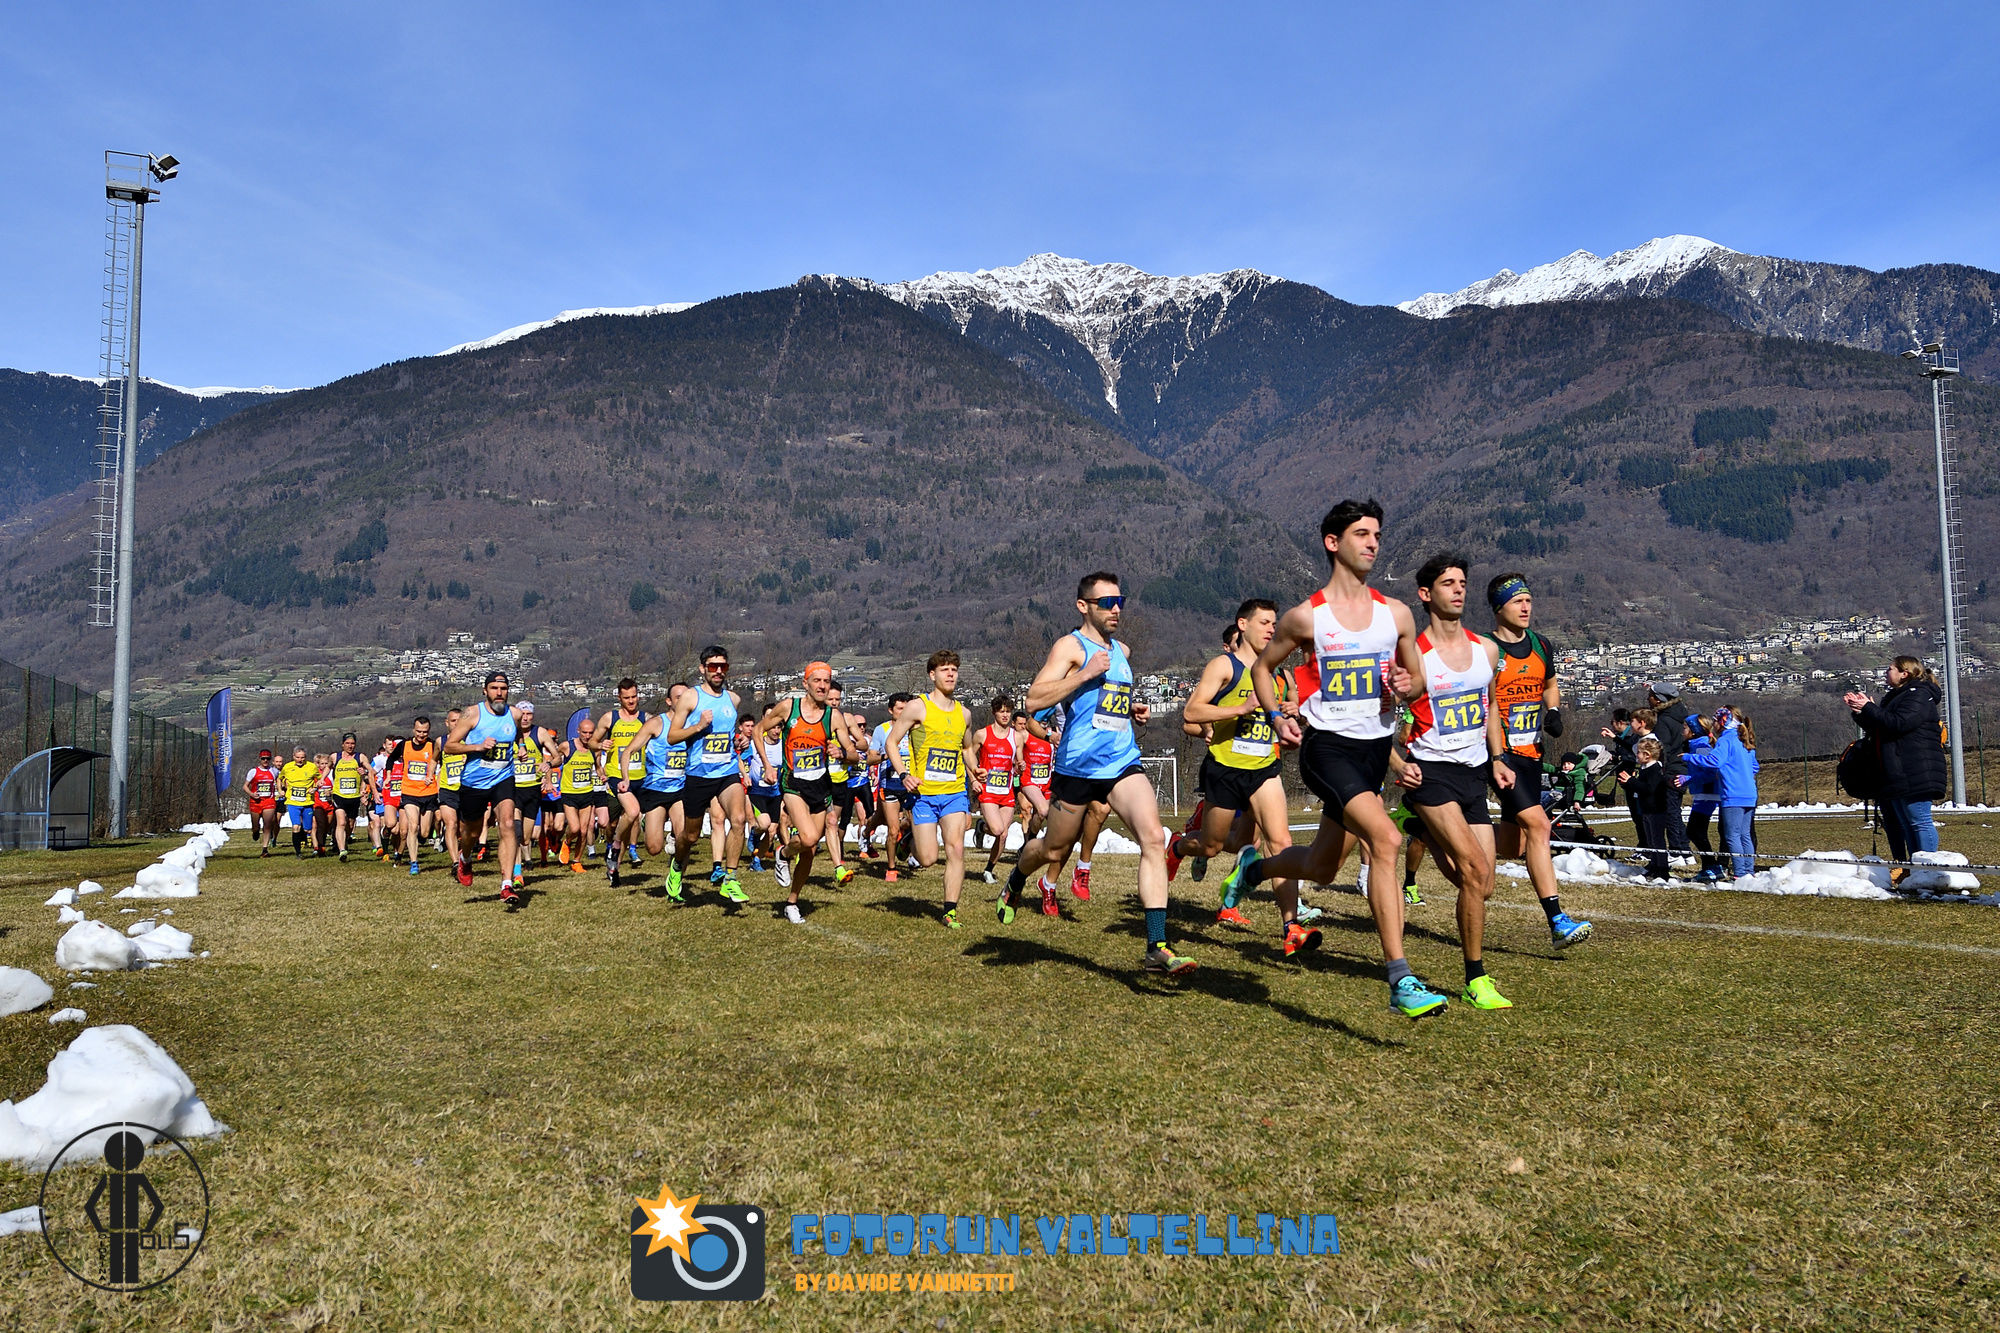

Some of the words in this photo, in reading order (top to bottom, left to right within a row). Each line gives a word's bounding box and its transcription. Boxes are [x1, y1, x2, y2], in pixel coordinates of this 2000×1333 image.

[1326, 669, 1374, 697] 411
[1101, 692, 1131, 715] 423
[1443, 703, 1483, 729] 412
[1513, 711, 1539, 731] 417
[1240, 722, 1272, 741] 399
[218, 722, 226, 772] MARATHON
[705, 739, 730, 752] 427
[485, 748, 507, 760] 431
[514, 763, 534, 774] 397
[667, 756, 687, 768] 425
[796, 754, 821, 770] 421
[929, 756, 956, 772] 480
[408, 765, 426, 774] 485
[1032, 768, 1049, 778] 450
[574, 773, 590, 782] 394
[989, 775, 1008, 787] 463
[292, 790, 306, 798] 475
